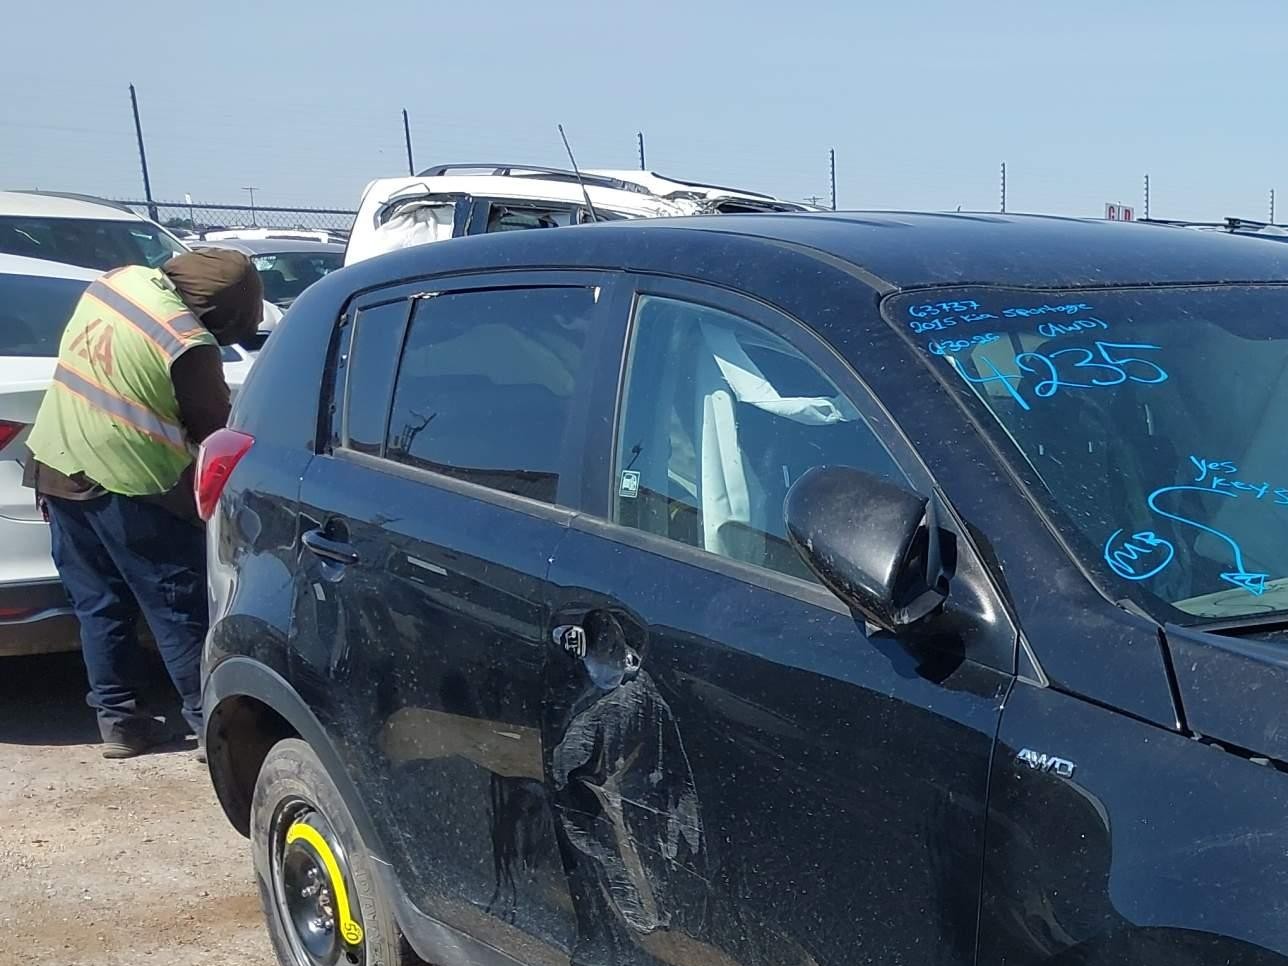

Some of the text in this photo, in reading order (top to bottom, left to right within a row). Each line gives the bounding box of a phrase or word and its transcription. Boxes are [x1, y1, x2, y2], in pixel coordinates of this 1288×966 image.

[909, 300, 981, 318] 63737
[910, 316, 957, 334] 2015
[954, 340, 1170, 411] 4235
[1016, 748, 1075, 778] AWD
[344, 922, 359, 942] 50
